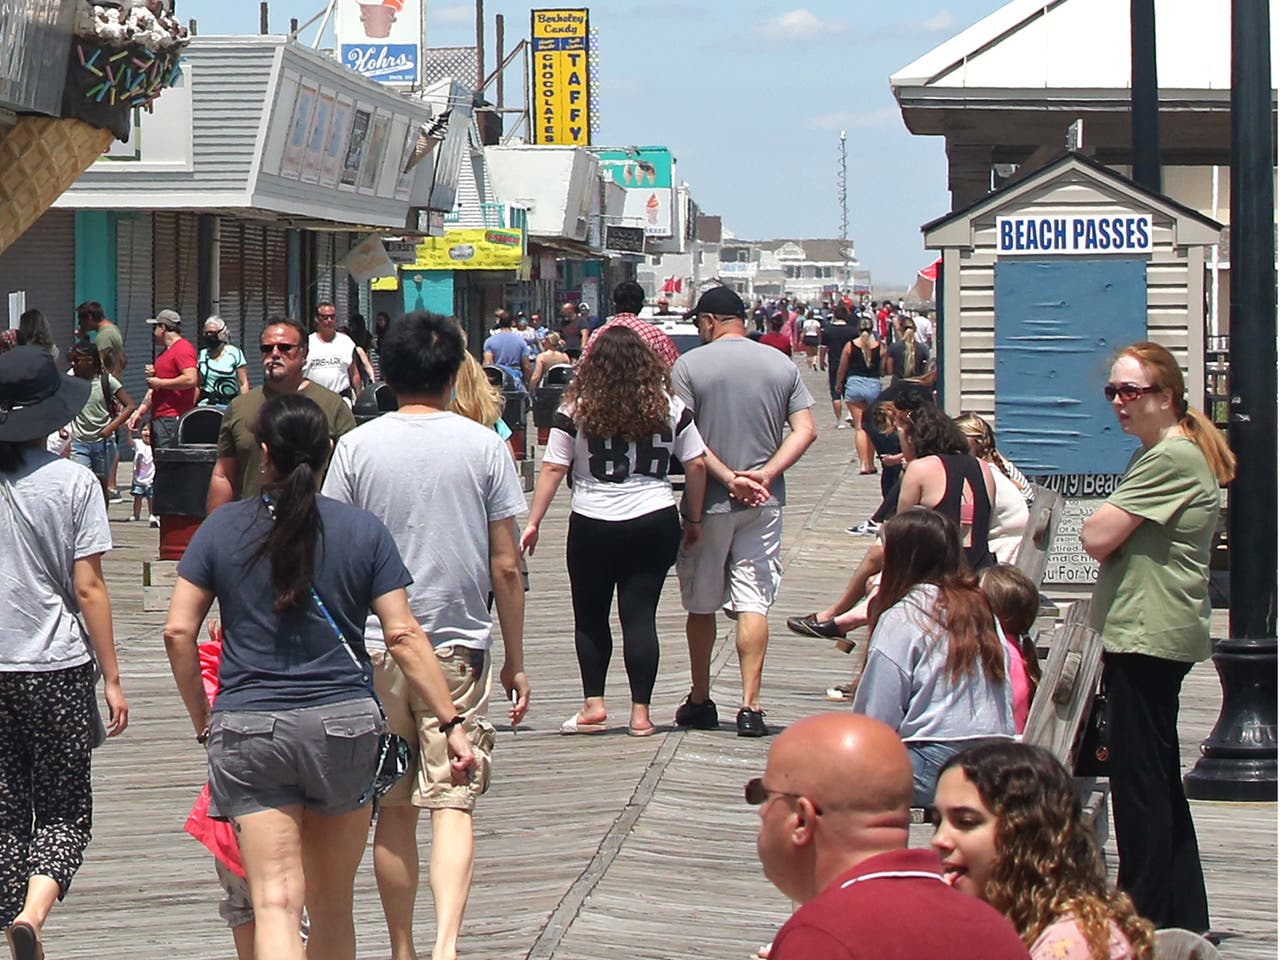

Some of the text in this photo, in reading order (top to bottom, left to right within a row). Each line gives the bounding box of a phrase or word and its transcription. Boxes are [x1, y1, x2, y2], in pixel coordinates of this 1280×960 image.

[544, 25, 578, 34] Candy
[542, 54, 555, 142] CHOCOLATES
[568, 54, 581, 141] TAFFY
[1000, 216, 1150, 251] BEACH PASSES
[588, 433, 671, 483] 86
[1060, 566, 1079, 580] For
